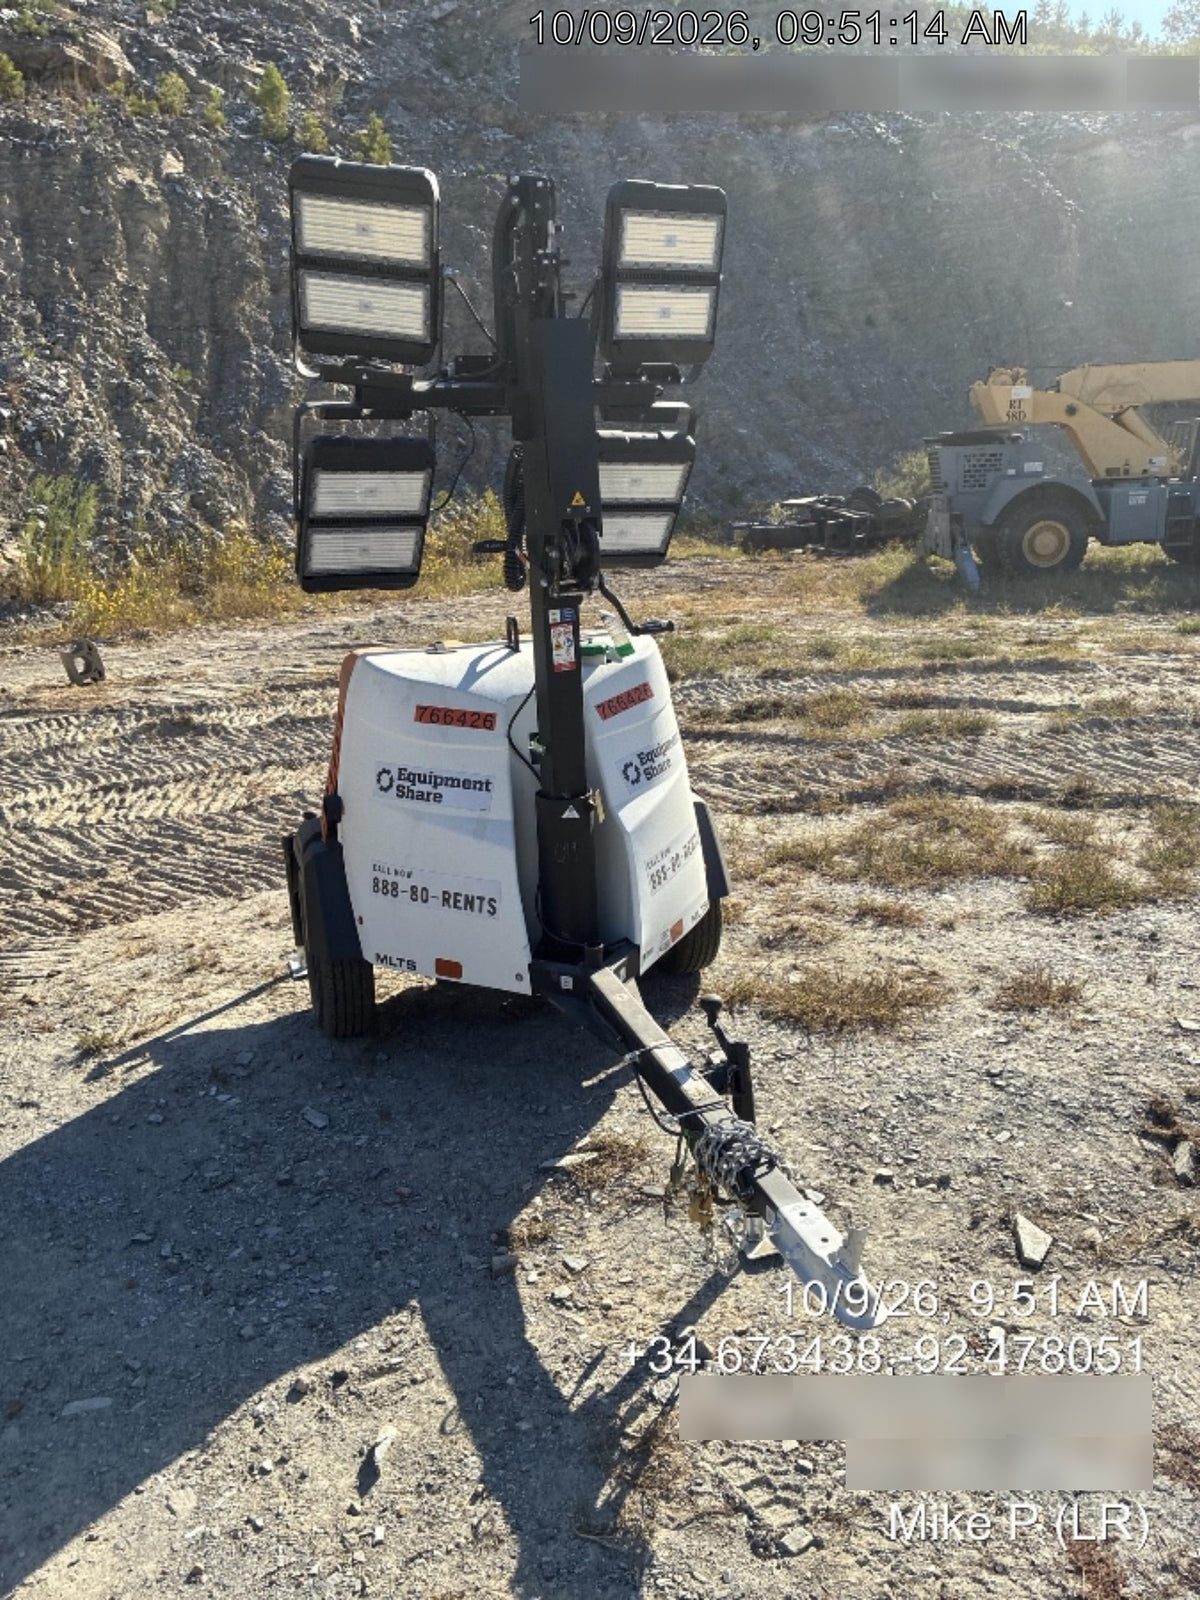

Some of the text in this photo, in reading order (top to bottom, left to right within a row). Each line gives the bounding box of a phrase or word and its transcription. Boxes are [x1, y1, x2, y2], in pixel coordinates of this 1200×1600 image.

[595, 683, 654, 719] 766426
[418, 706, 495, 730] 766426
[397, 767, 493, 792] Equipment
[395, 784, 443, 803] Share
[372, 876, 497, 916] 888-80-RENTS
[375, 952, 417, 971] MLTS
